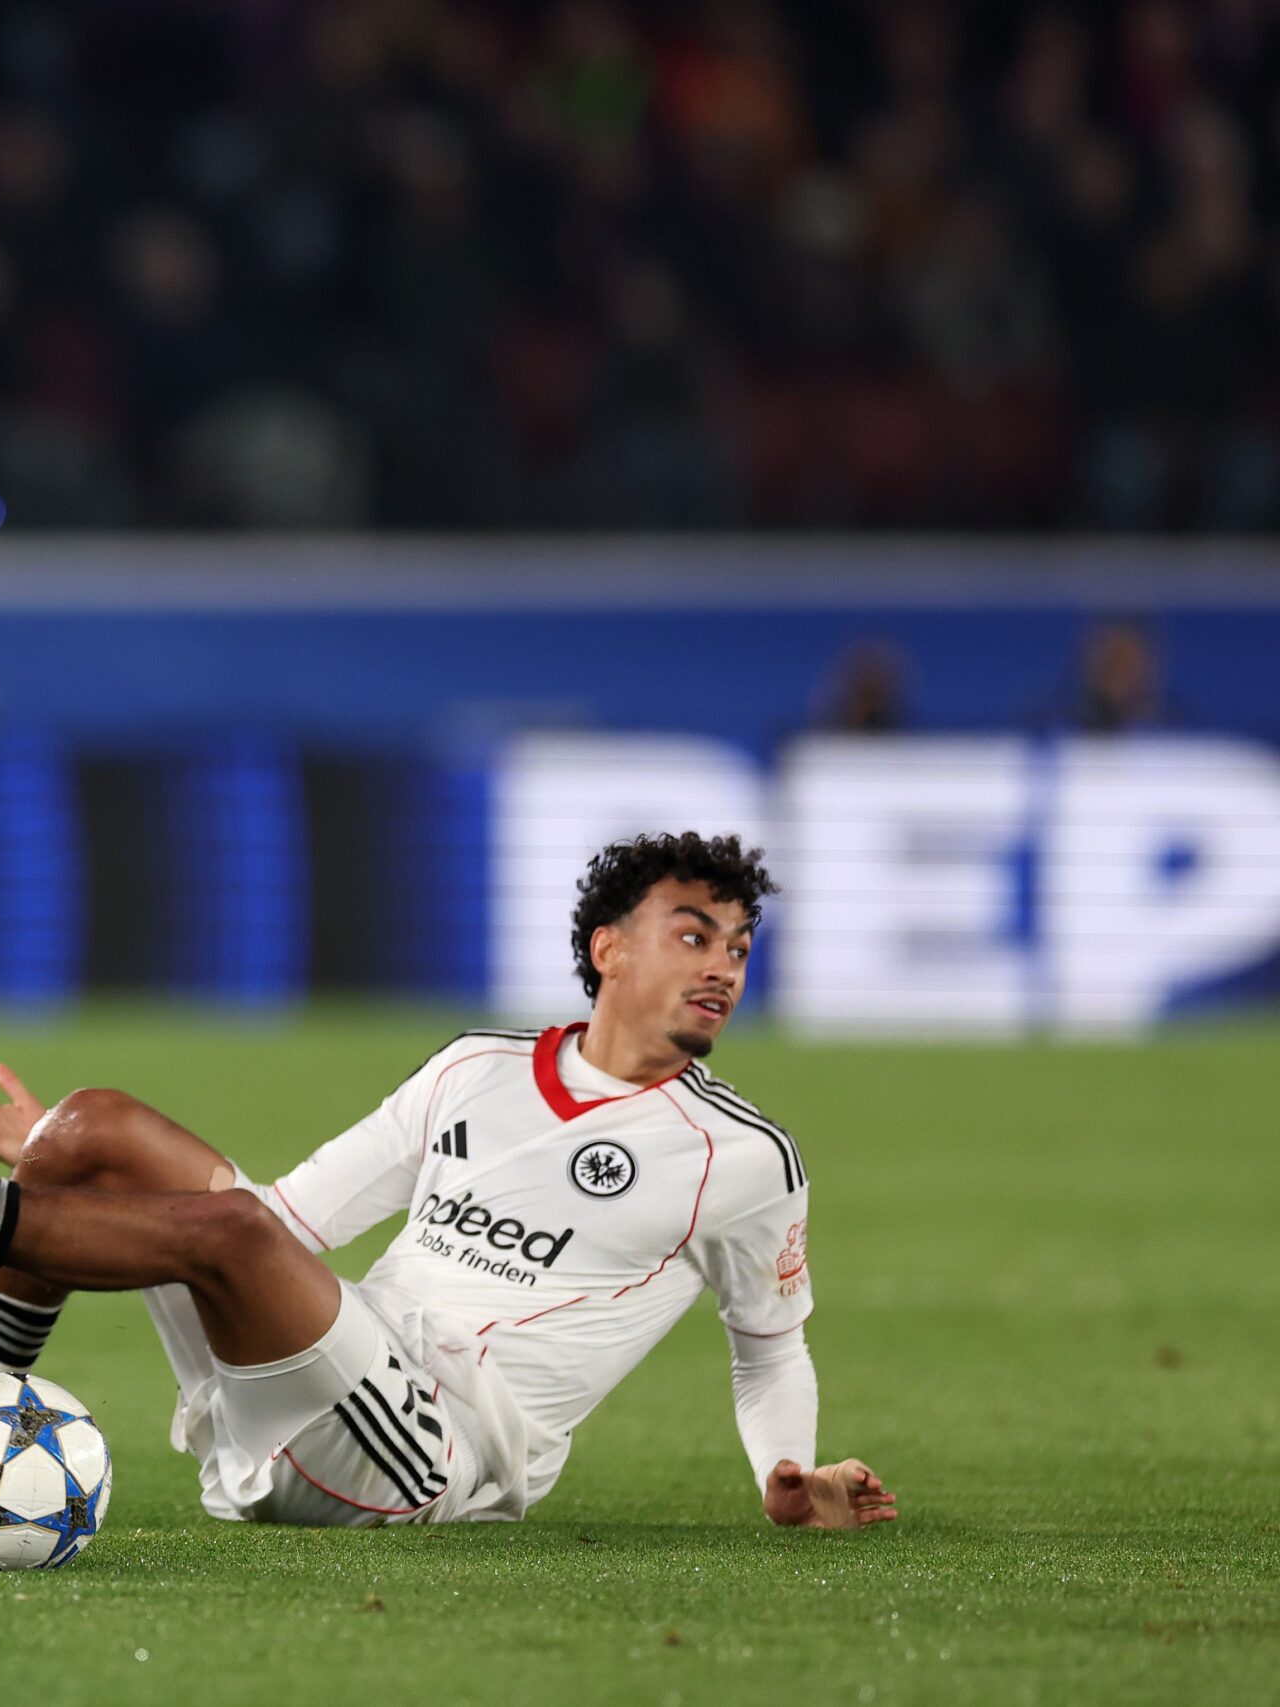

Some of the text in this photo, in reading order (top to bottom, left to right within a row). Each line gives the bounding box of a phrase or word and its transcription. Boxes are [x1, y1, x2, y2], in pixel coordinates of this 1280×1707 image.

[414, 1192, 574, 1268] ndeed
[416, 1228, 537, 1288] Jobs finden
